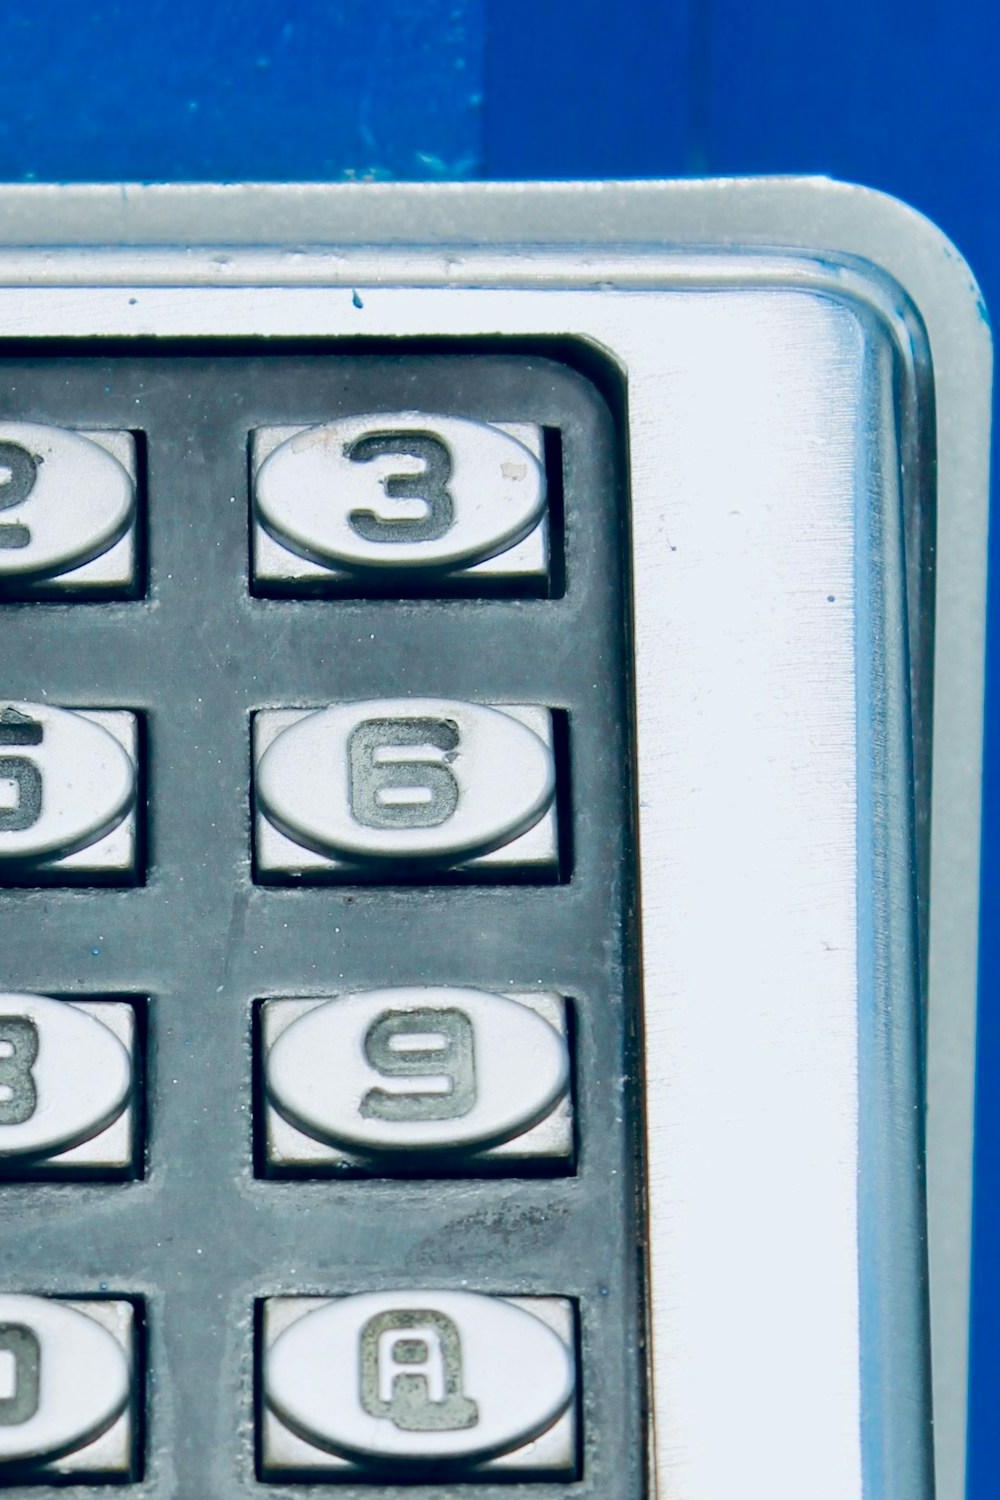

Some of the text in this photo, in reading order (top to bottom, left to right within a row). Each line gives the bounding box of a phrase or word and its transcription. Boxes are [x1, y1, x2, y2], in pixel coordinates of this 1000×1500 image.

[347, 430, 456, 543] 3
[346, 717, 461, 830] 6
[360, 1008, 478, 1121] 9
